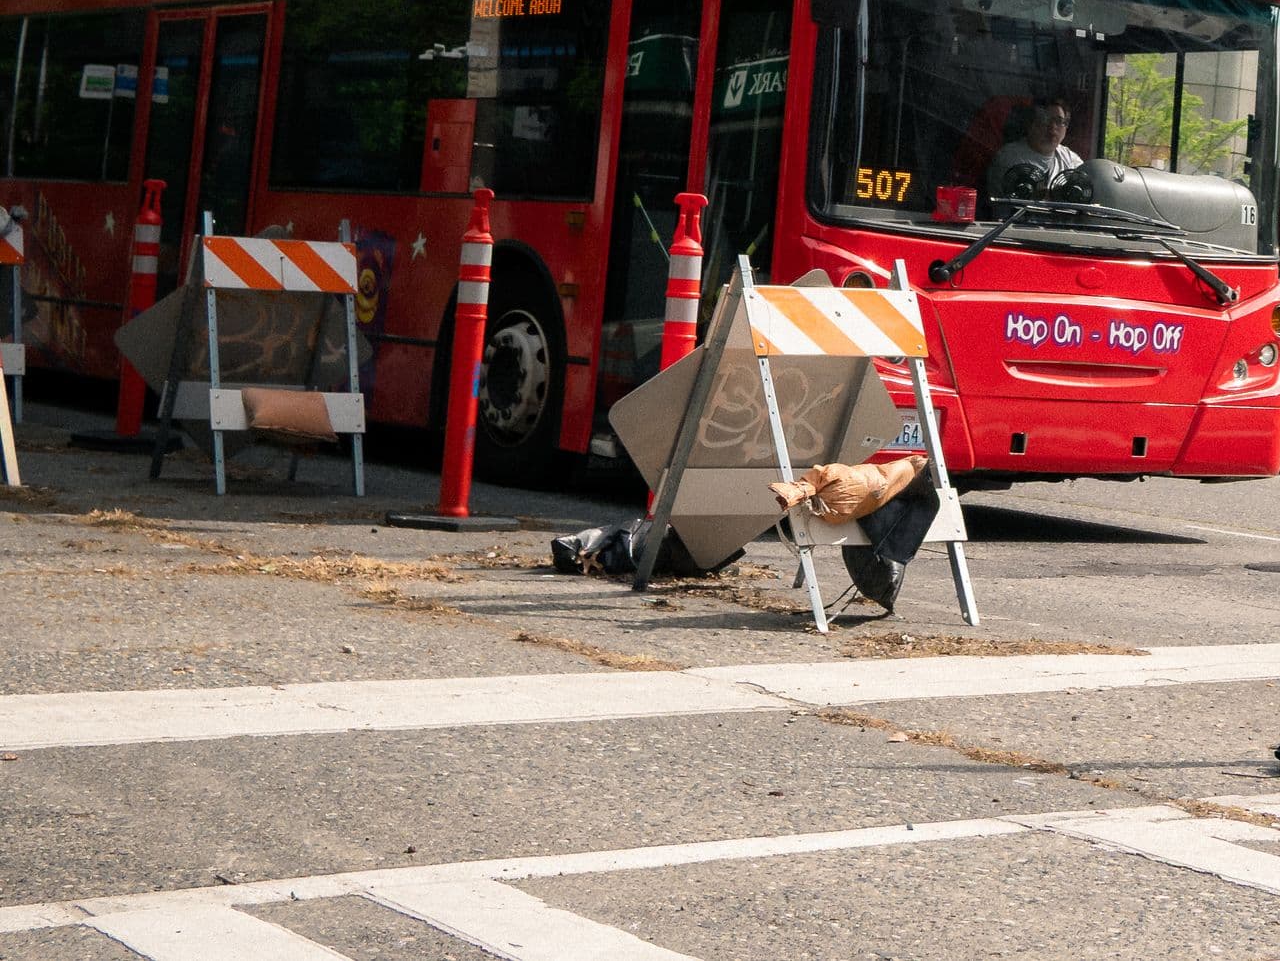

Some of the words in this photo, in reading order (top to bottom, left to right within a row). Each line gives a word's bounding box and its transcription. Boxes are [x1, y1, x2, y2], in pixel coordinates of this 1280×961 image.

[857, 167, 911, 202] 507
[1244, 205, 1256, 225] 16
[1006, 313, 1049, 345] Hop
[1054, 314, 1081, 343] On
[1109, 321, 1148, 352] Hop
[1153, 322, 1183, 350] Off
[896, 424, 920, 444] 64
